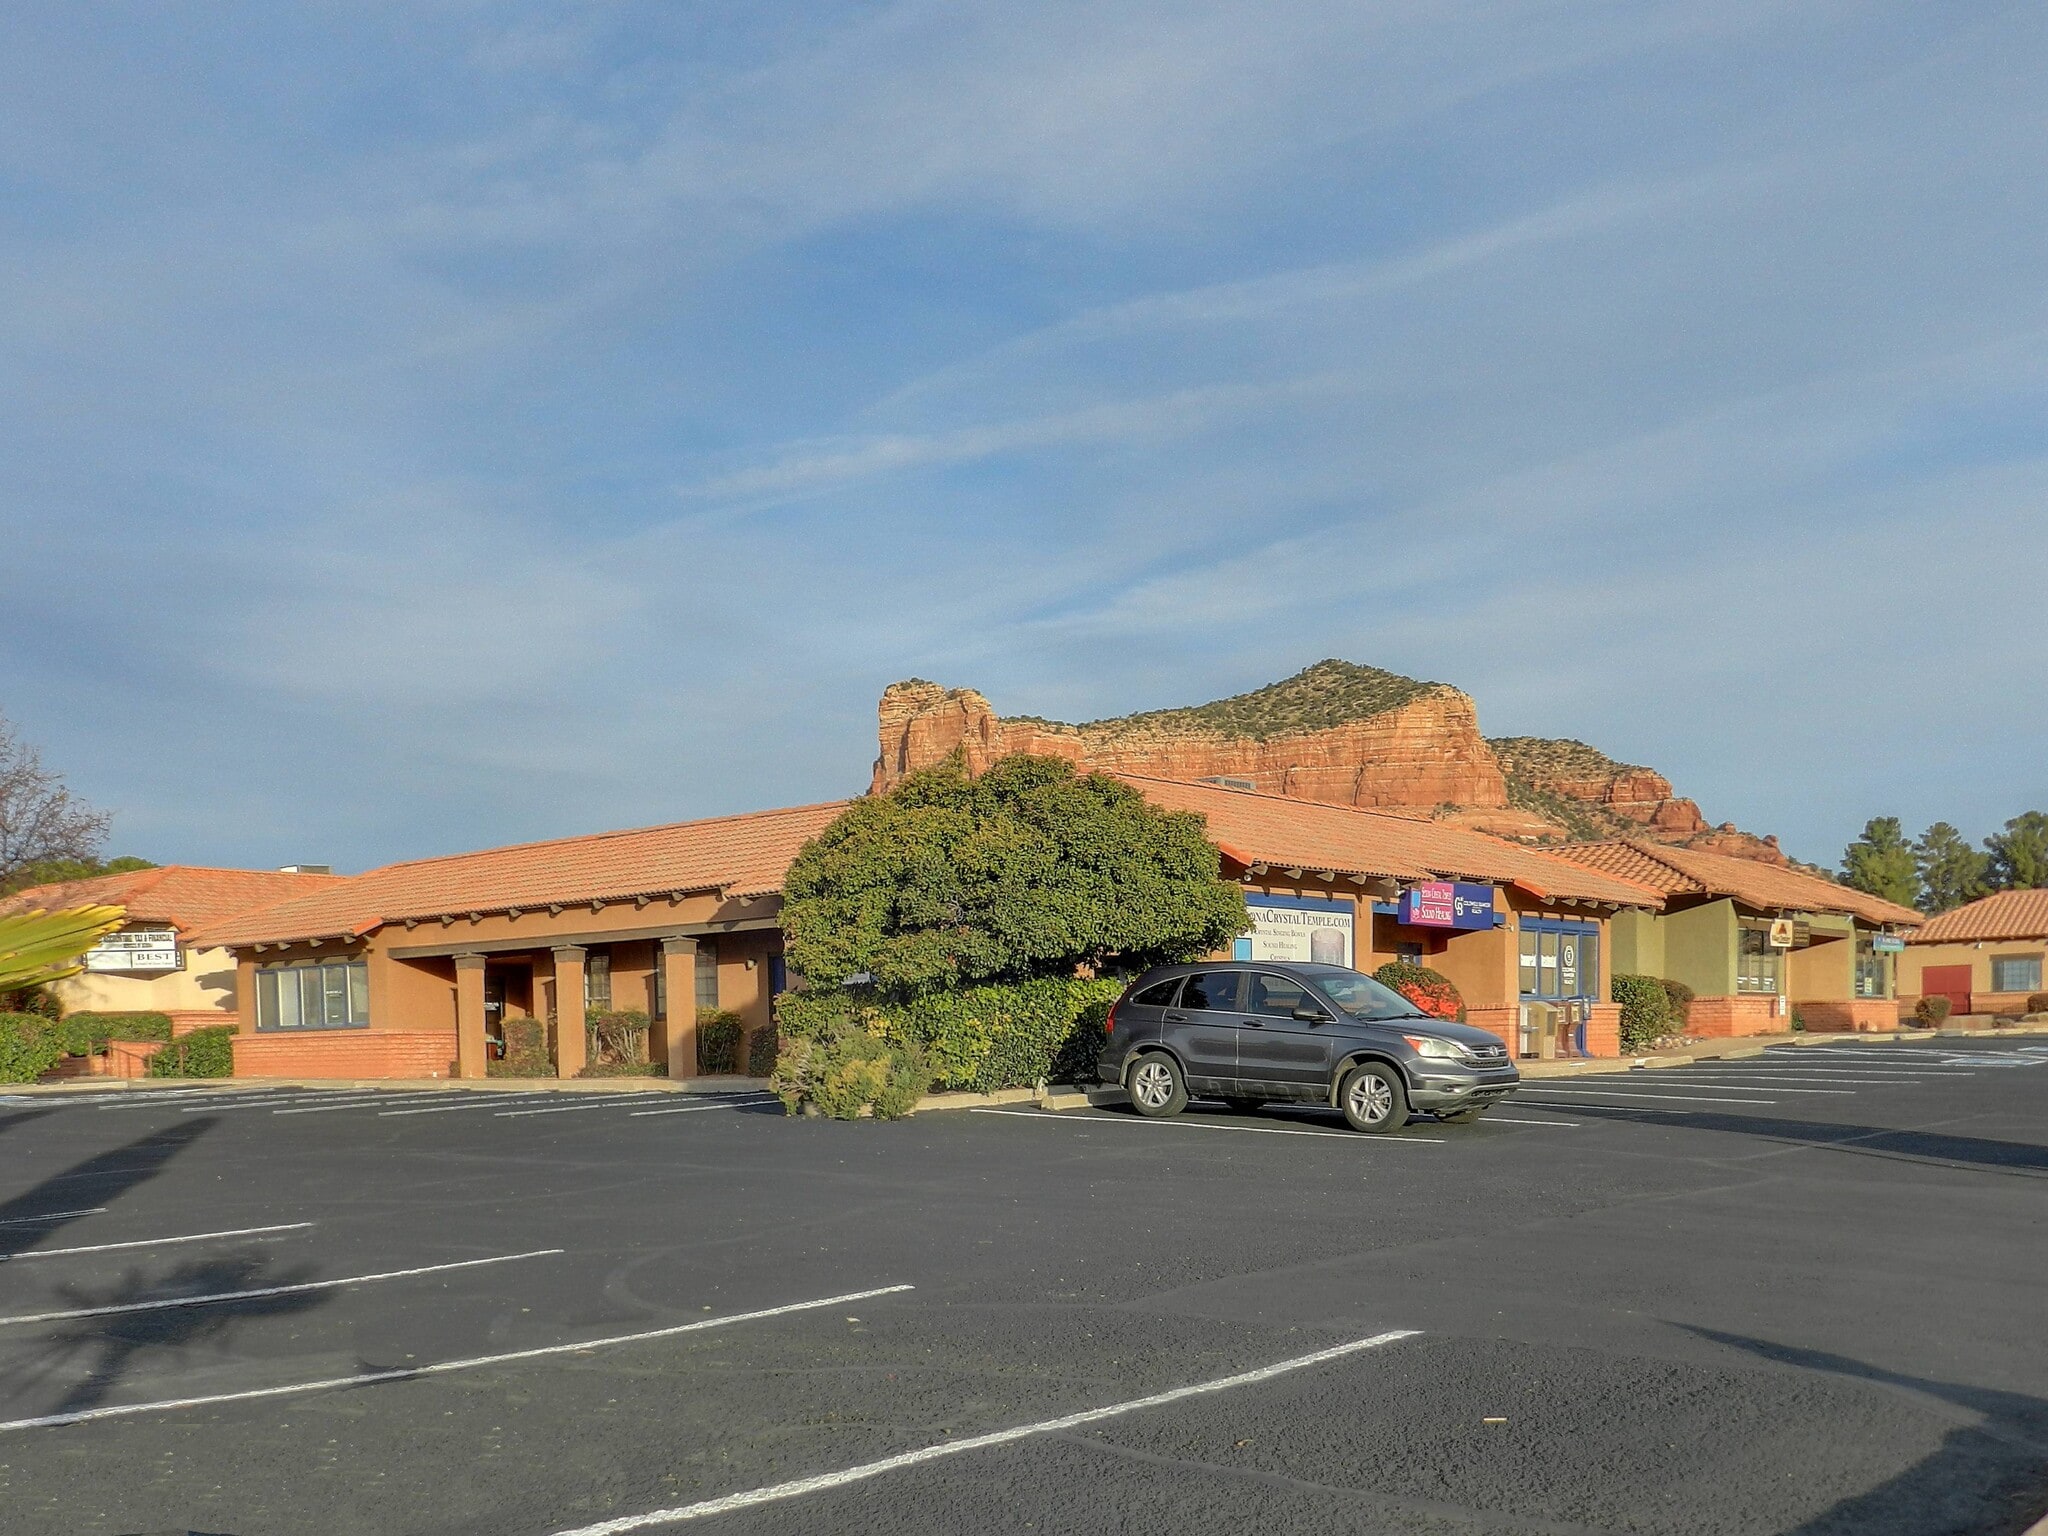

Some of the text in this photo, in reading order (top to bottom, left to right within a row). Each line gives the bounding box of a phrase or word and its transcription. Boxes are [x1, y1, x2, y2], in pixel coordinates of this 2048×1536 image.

[1421, 905, 1435, 918] SOUND
[1262, 941, 1298, 950] SOUND HEALING
[137, 953, 170, 961] BEST
